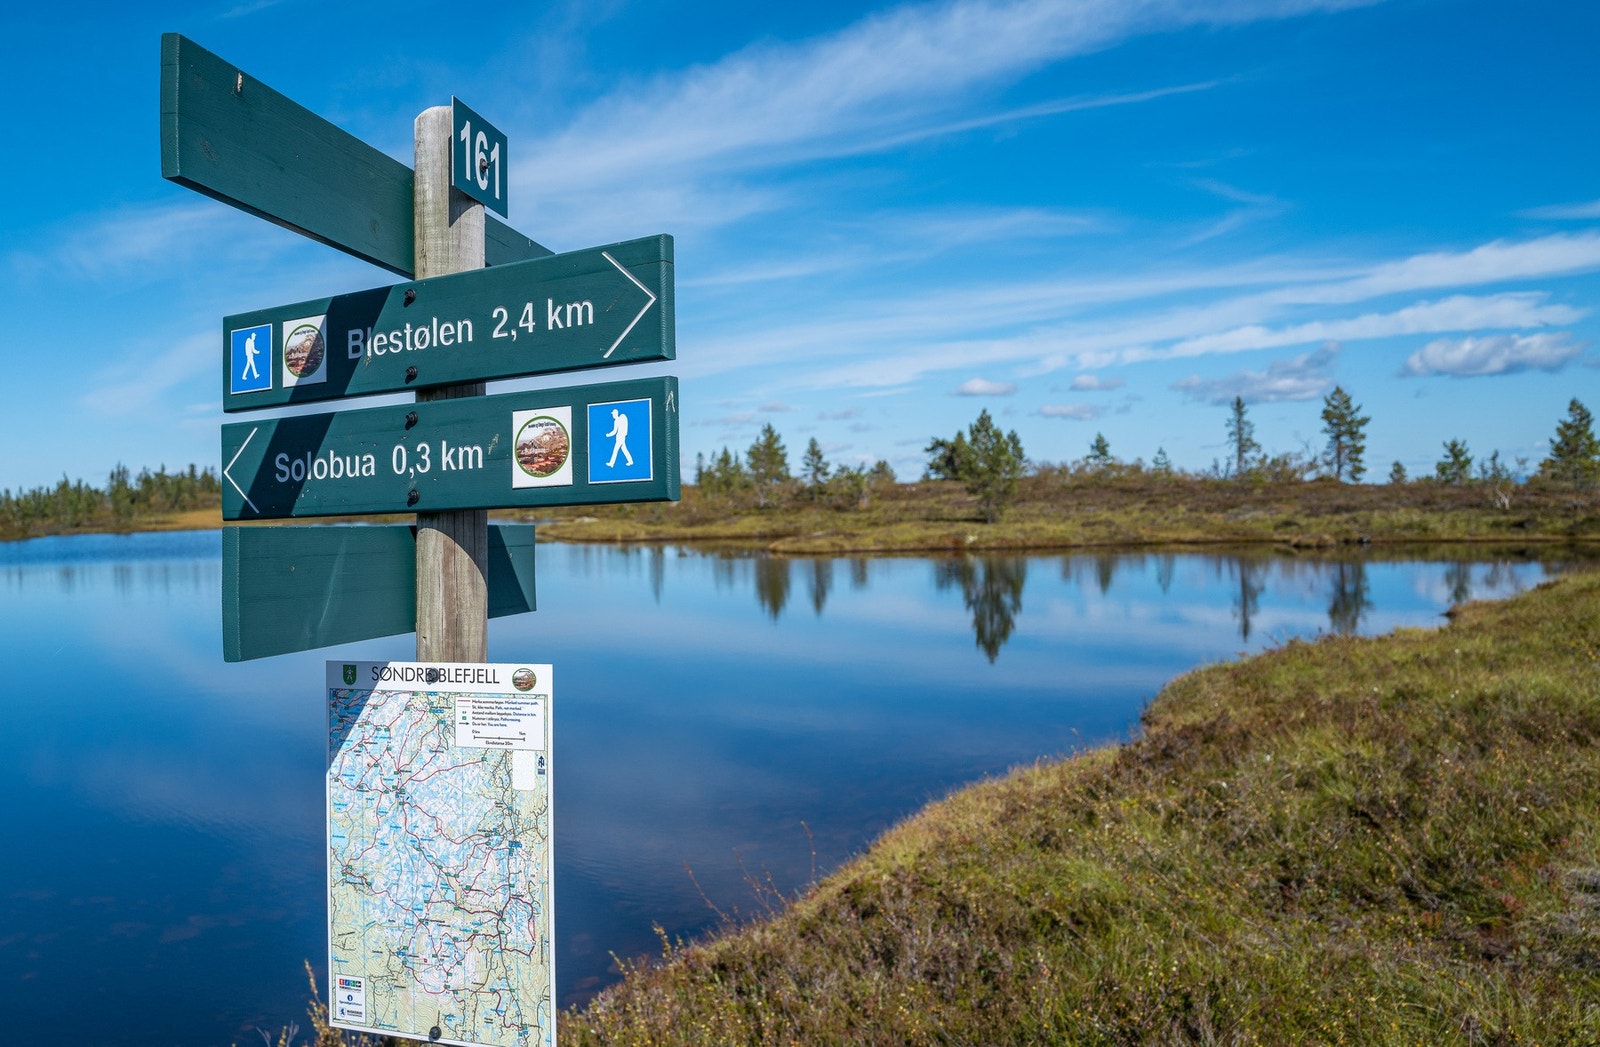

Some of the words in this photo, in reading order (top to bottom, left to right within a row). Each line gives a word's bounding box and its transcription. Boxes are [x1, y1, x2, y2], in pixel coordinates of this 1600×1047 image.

[461, 120, 500, 200] 161
[347, 316, 474, 360] Blestølen
[492, 301, 536, 342] 2,4
[547, 298, 594, 330] km
[274, 449, 376, 483] Solobua
[392, 442, 431, 479] 0,3
[441, 440, 483, 471] km
[438, 667, 500, 684] BLEFJELL
